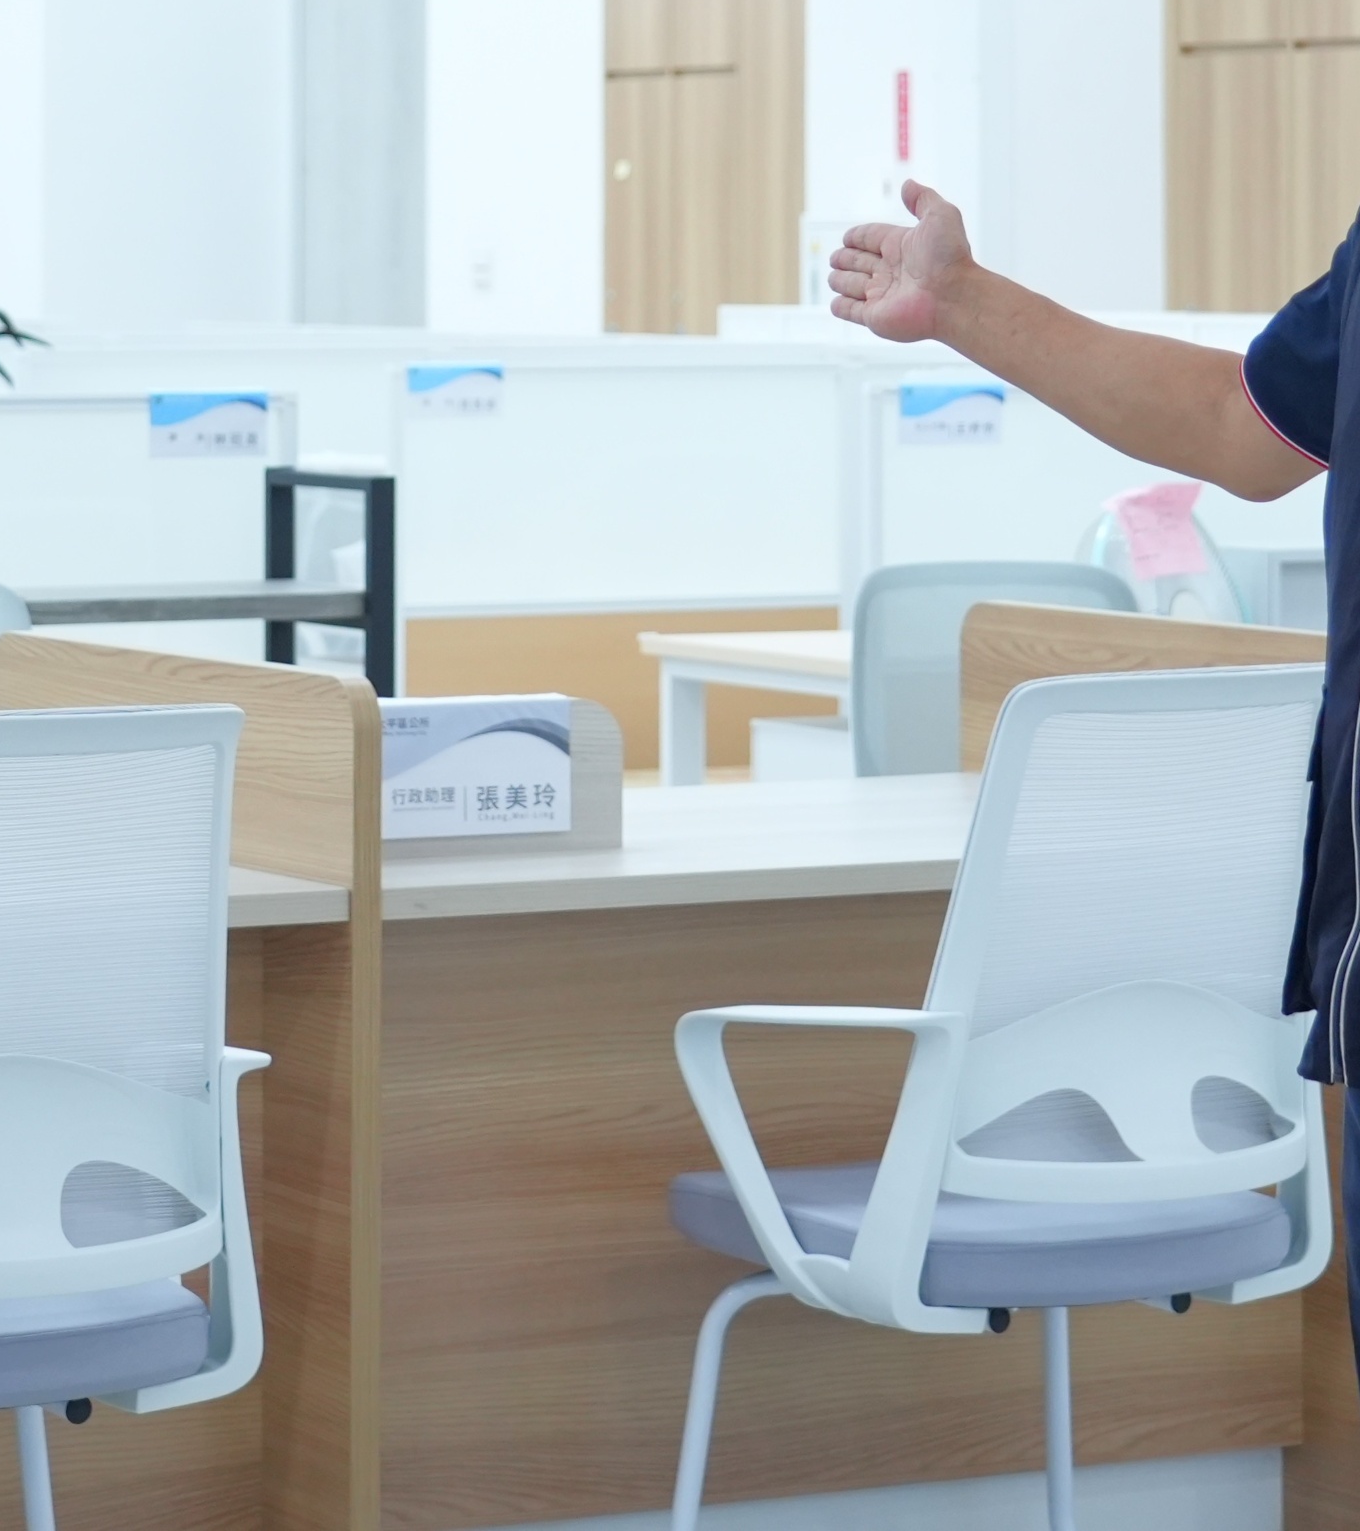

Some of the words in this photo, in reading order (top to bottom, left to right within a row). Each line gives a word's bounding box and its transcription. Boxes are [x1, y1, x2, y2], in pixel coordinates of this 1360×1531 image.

[392, 786, 456, 805] 行政助理
[476, 782, 557, 812] 張美玲
